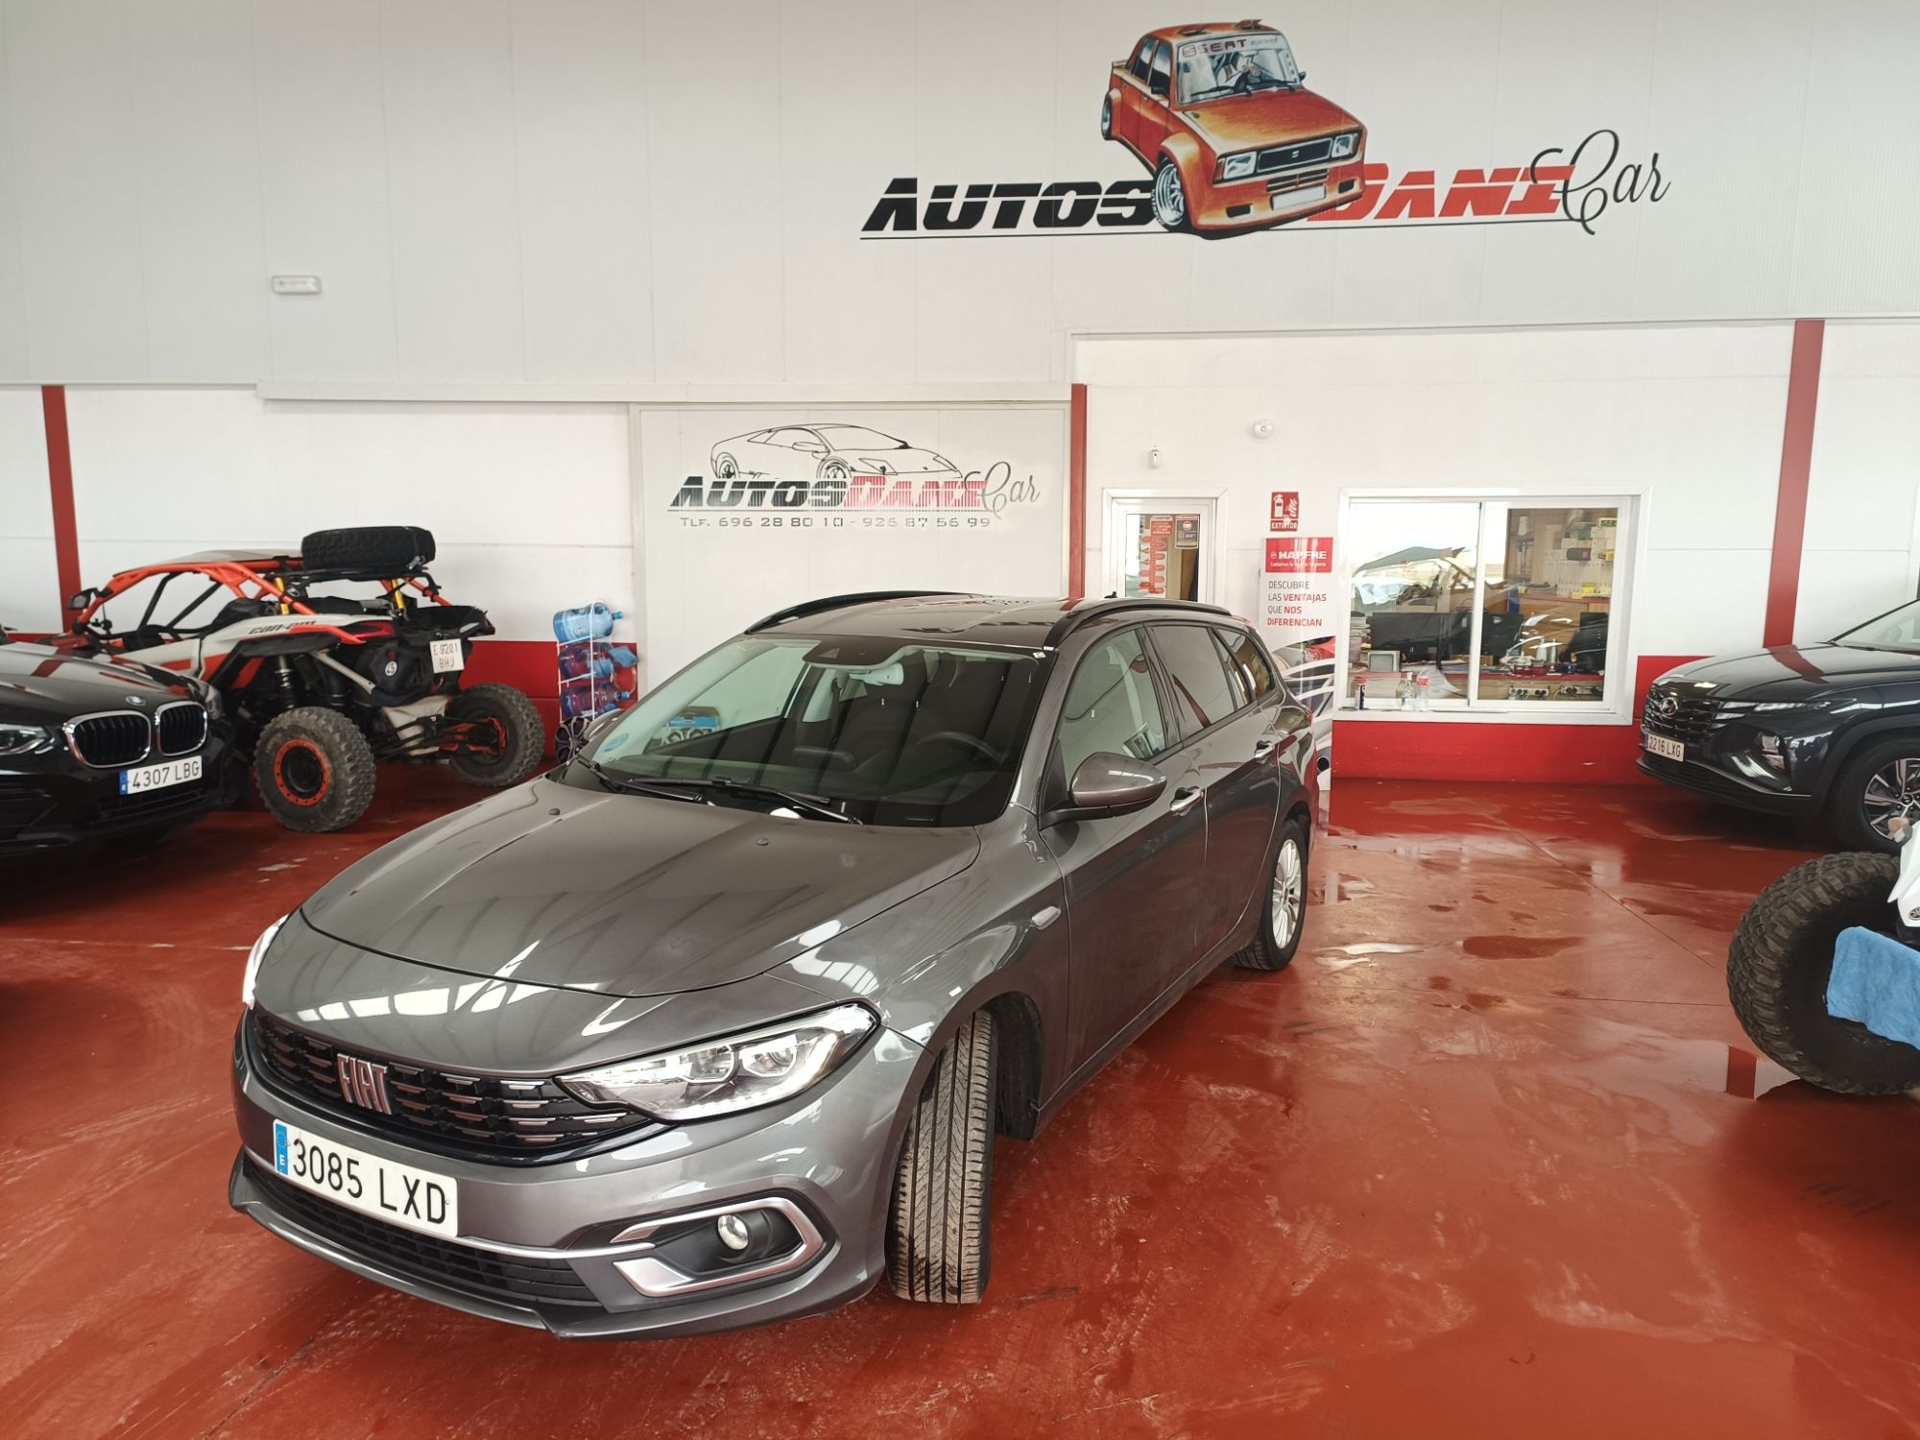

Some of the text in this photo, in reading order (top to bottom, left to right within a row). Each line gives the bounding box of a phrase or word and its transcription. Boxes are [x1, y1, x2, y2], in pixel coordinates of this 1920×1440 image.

[861, 177, 1160, 231] AUTOS
[1307, 162, 1575, 222] DANI
[1530, 129, 1671, 236] Car
[670, 461, 1041, 520] AUTOS DANI Car
[719, 517, 753, 527] 696
[761, 517, 783, 527] 28
[791, 517, 813, 527] 80
[824, 517, 844, 527] 10
[937, 517, 959, 527] 56
[967, 517, 990, 527] 99
[1268, 580, 1311, 590] DESCUBRE
[1268, 592, 1328, 604] LAS VENTAJAS
[1267, 605, 1303, 615] QUE NOS
[1267, 617, 1323, 627] DIFERENCIAN
[1667, 742, 1682, 758] LXG
[132, 760, 200, 789] 4307 LBG
[337, 1053, 392, 1116] FIAT
[279, 1138, 447, 1225] E 3085 LXD
